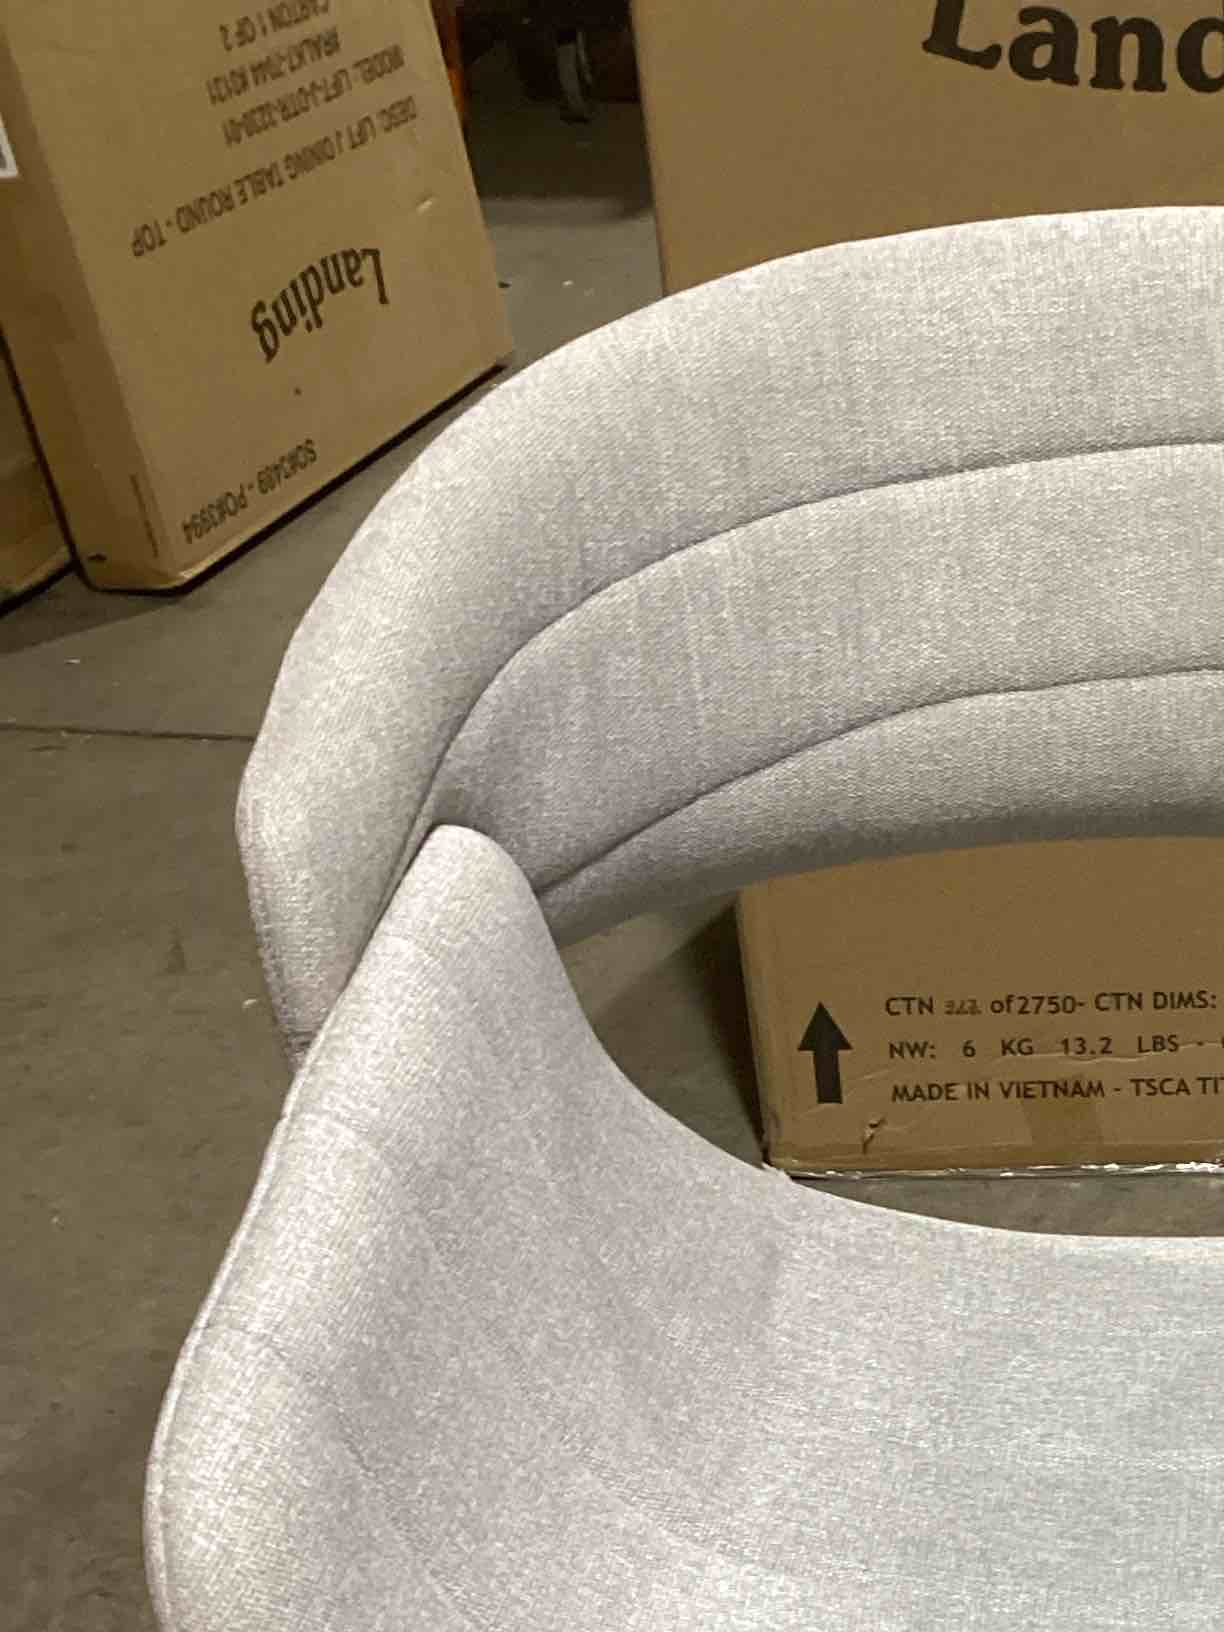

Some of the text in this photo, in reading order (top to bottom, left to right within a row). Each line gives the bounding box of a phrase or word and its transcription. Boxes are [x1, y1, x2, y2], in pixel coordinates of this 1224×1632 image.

[234, 162, 285, 206] TABLE
[175, 187, 235, 235] ROUND
[131, 218, 168, 258] TOP
[250, 247, 389, 365] Landing
[884, 996, 934, 1016] CTN
[1094, 991, 1143, 1012] CTN
[1153, 989, 1217, 1011] DIMS:
[888, 1040, 937, 1060] NW:
[961, 1039, 977, 1058] 6
[1001, 1037, 1035, 1057] KG
[1060, 1035, 1113, 1056] 13.2
[1137, 1033, 1180, 1054] LBS
[891, 1081, 961, 1102] MADE
[967, 1081, 990, 1101] IN
[1000, 1079, 1106, 1100] VIETNAM
[1130, 1077, 1192, 1098] TSCA
